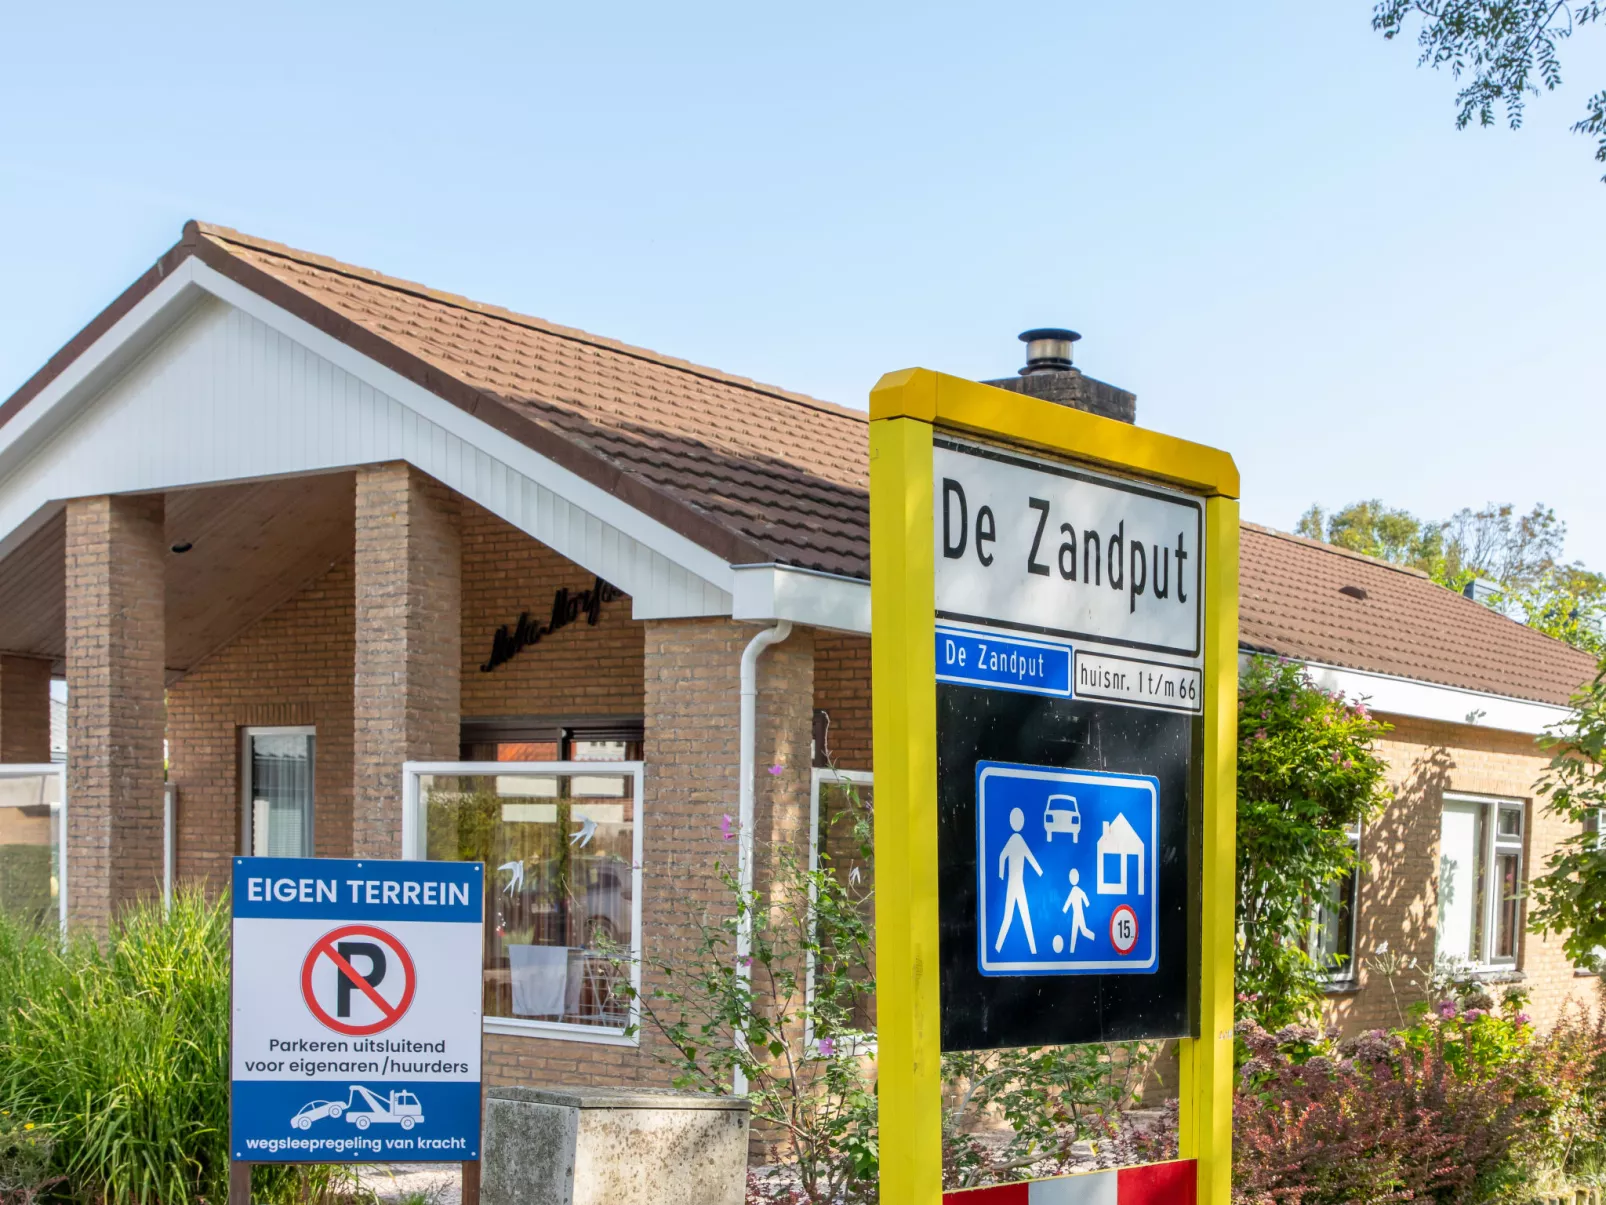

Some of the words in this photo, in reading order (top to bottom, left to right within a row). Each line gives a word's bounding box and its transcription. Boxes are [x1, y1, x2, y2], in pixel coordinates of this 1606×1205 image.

[943, 477, 996, 567] De
[1028, 496, 1188, 614] Zandput
[945, 639, 966, 667] De
[977, 644, 1044, 680] Zandput
[1080, 662, 1130, 691] huisnr.
[1179, 677, 1196, 700] 66
[247, 877, 337, 903] EIGEN
[346, 880, 470, 906] TERREIN
[1117, 919, 1131, 939] 15
[337, 941, 386, 1017] P
[269, 1038, 348, 1053] Parkeren
[353, 1039, 446, 1054] uitsluitend
[245, 1060, 285, 1072] voor
[246, 1136, 382, 1153] wegsleepregeling
[385, 1138, 414, 1149] van
[417, 1136, 466, 1149] kracht
